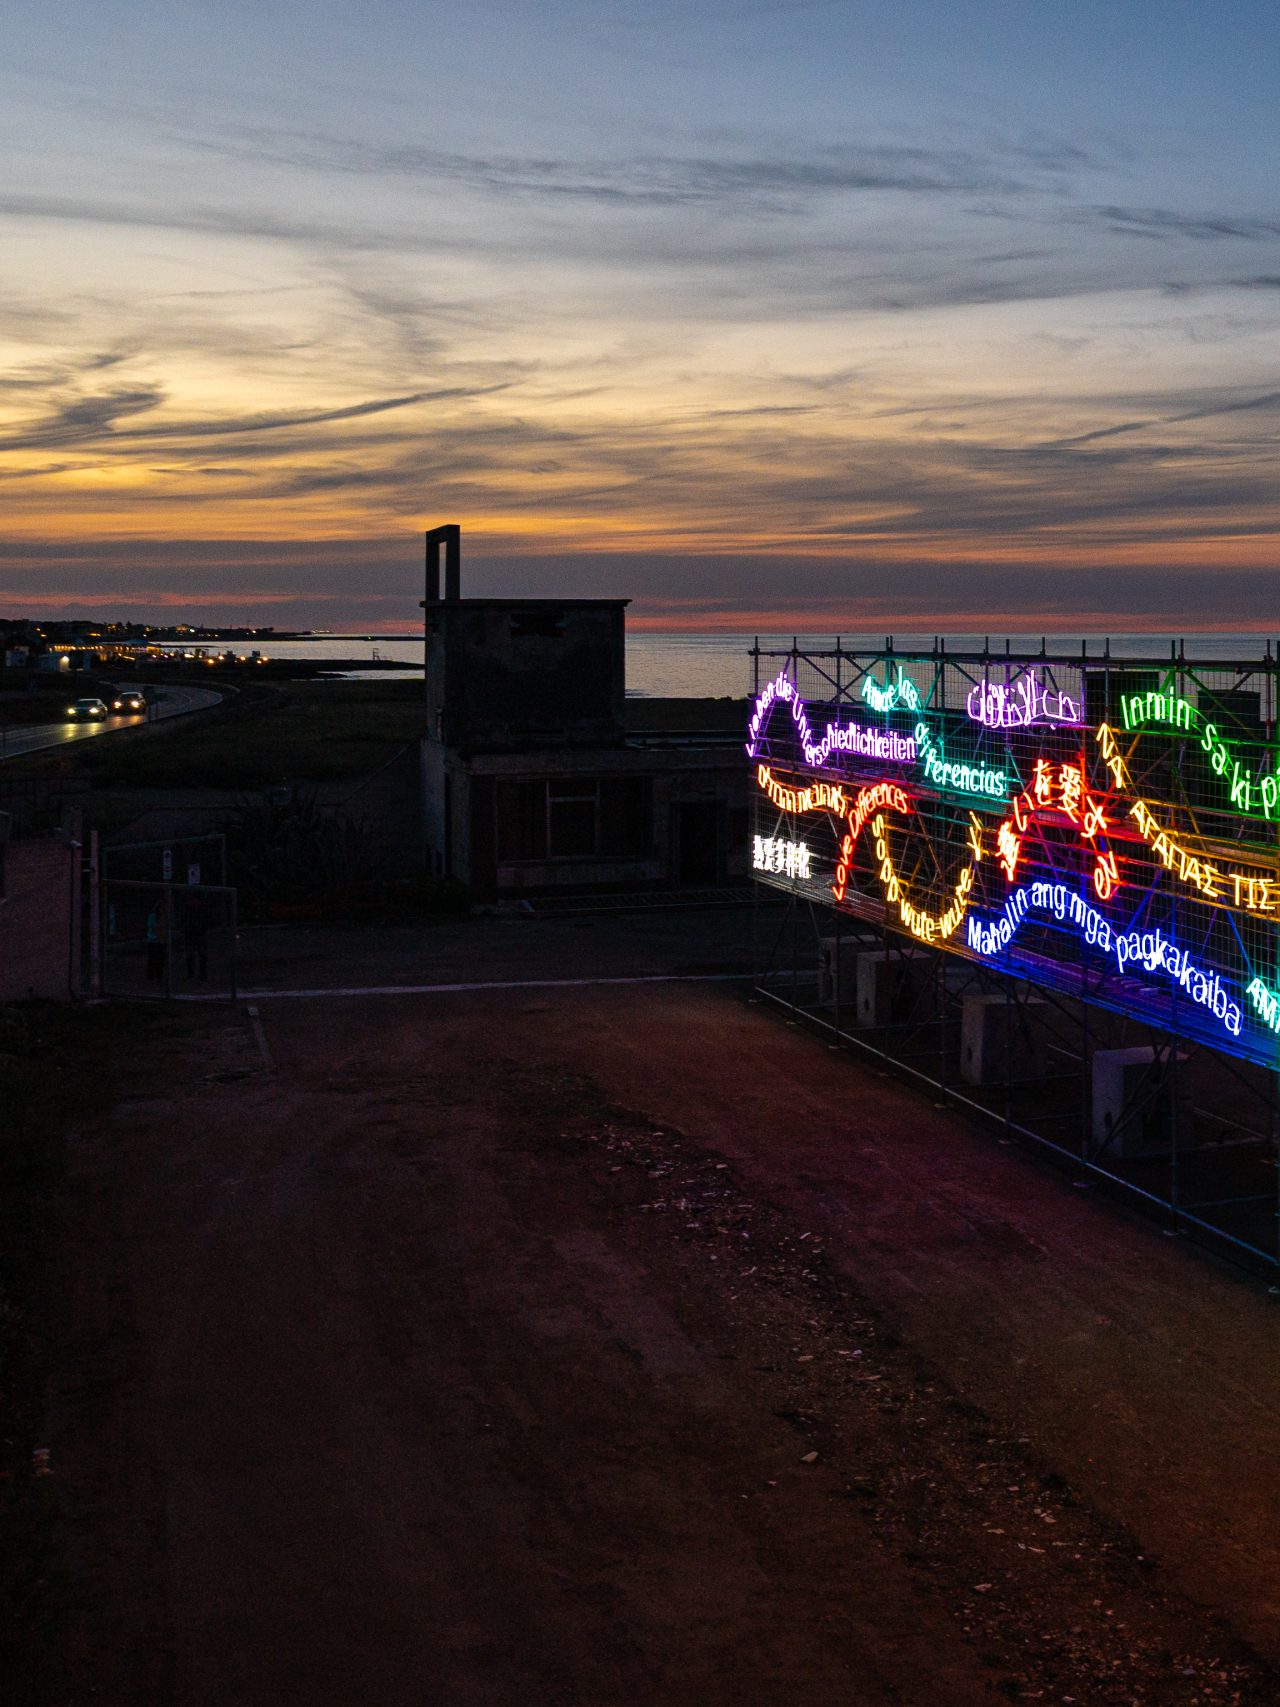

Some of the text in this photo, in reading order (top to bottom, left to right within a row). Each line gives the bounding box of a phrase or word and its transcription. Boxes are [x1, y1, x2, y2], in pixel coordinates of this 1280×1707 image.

[776, 671, 793, 701] die
[792, 693, 918, 766] Unterschiedlichkeiten
[862, 665, 1007, 797] Amar las diferencias
[1201, 723, 1227, 775] sa
[1231, 762, 1251, 811] ki
[832, 783, 908, 901] Love Differences
[967, 881, 1241, 1035] Mahalin ang mga pagkakaiba
